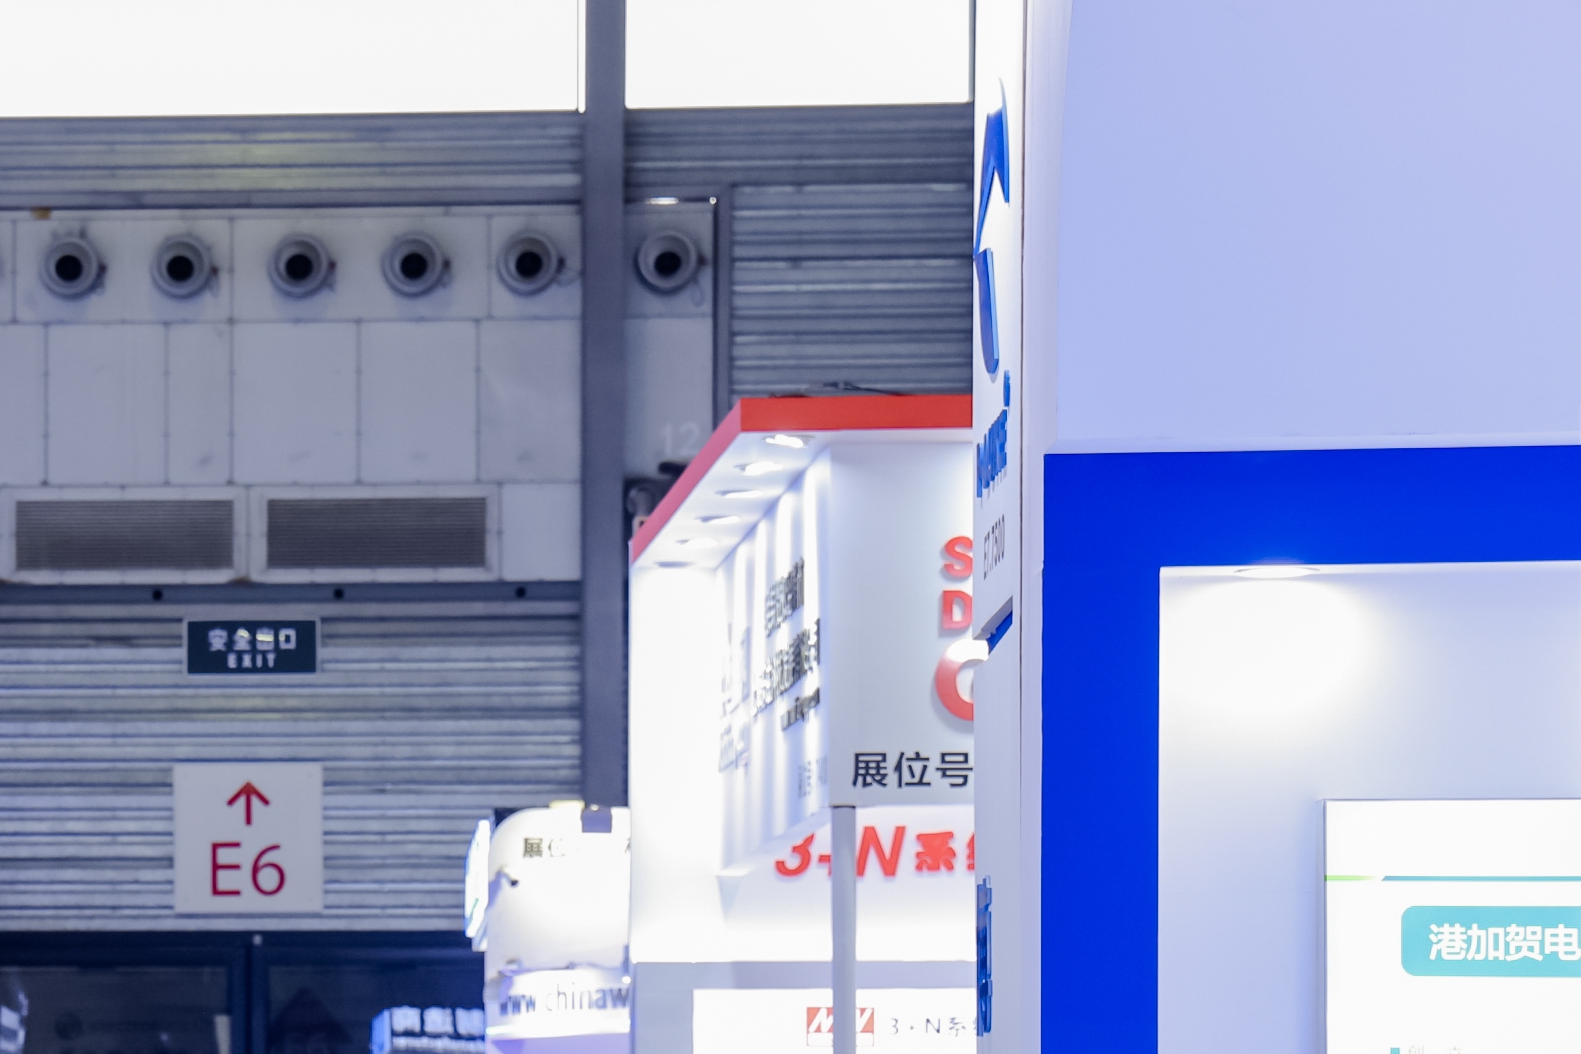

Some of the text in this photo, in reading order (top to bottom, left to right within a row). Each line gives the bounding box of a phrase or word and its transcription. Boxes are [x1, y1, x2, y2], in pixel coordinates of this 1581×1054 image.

[227, 652, 277, 669] EXIT
[211, 842, 286, 897] E6
[1428, 922, 1581, 961] 港加贺电
